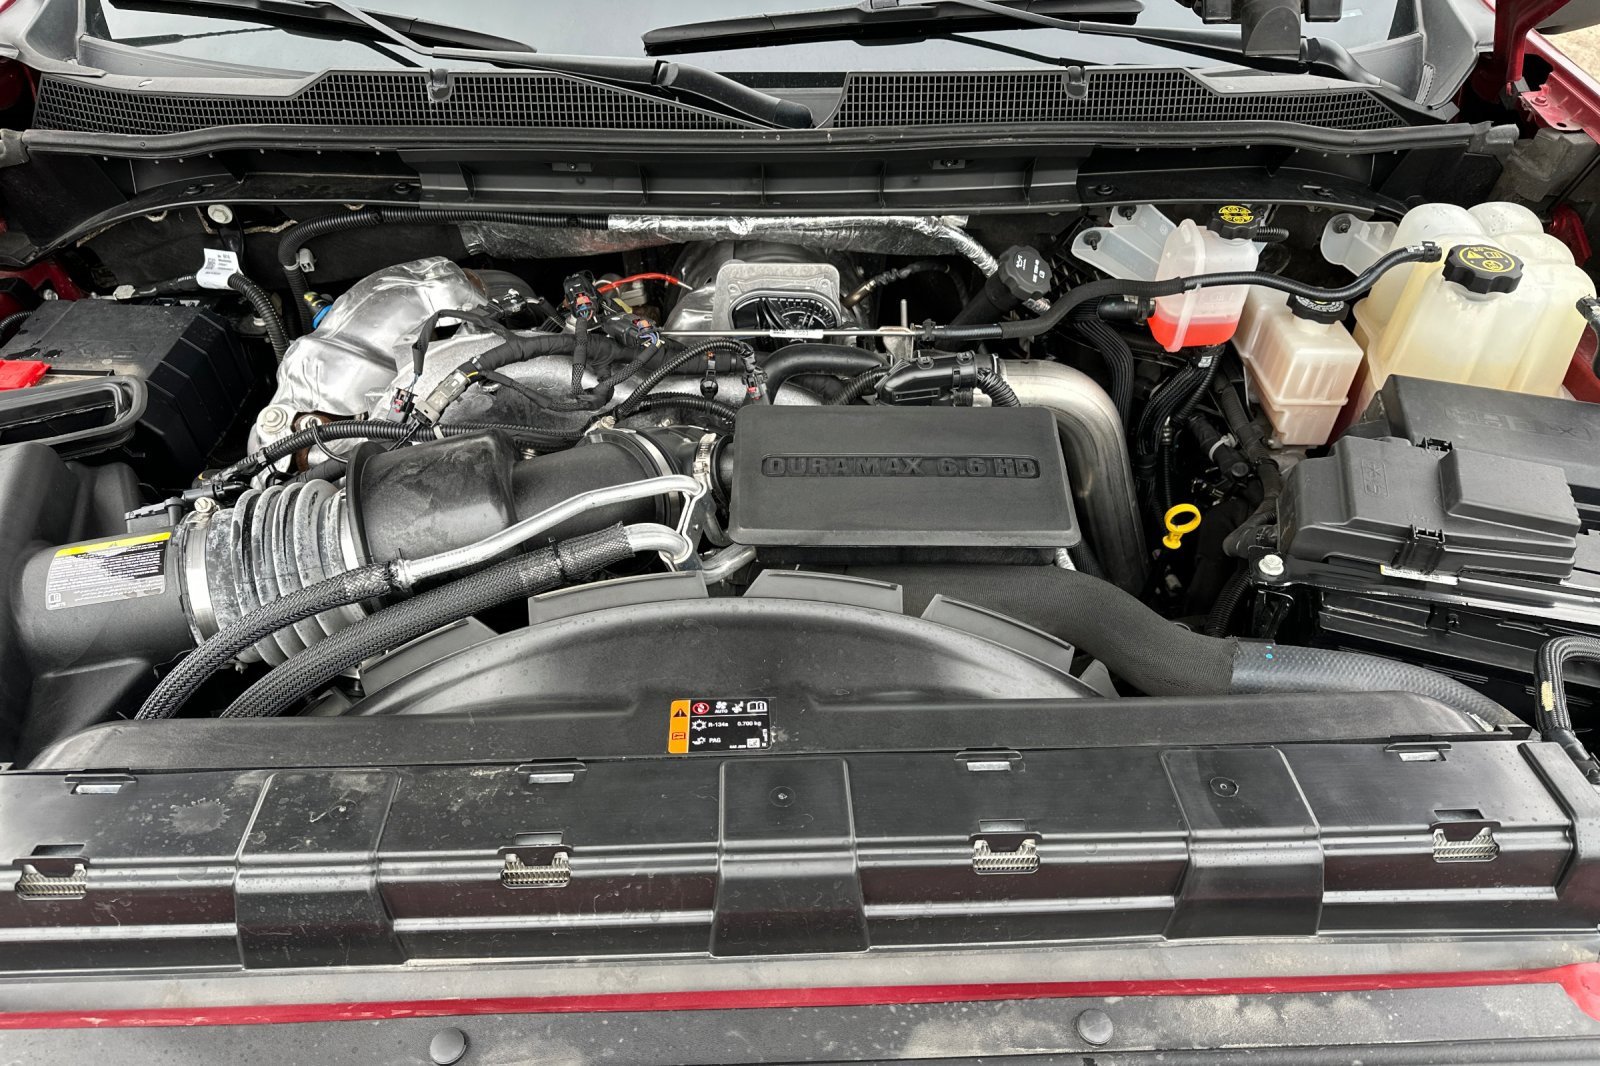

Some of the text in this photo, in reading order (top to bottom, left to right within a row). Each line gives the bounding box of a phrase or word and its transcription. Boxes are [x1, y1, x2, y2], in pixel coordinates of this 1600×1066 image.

[765, 456, 1038, 478] DURAMAX 6.6 HD
